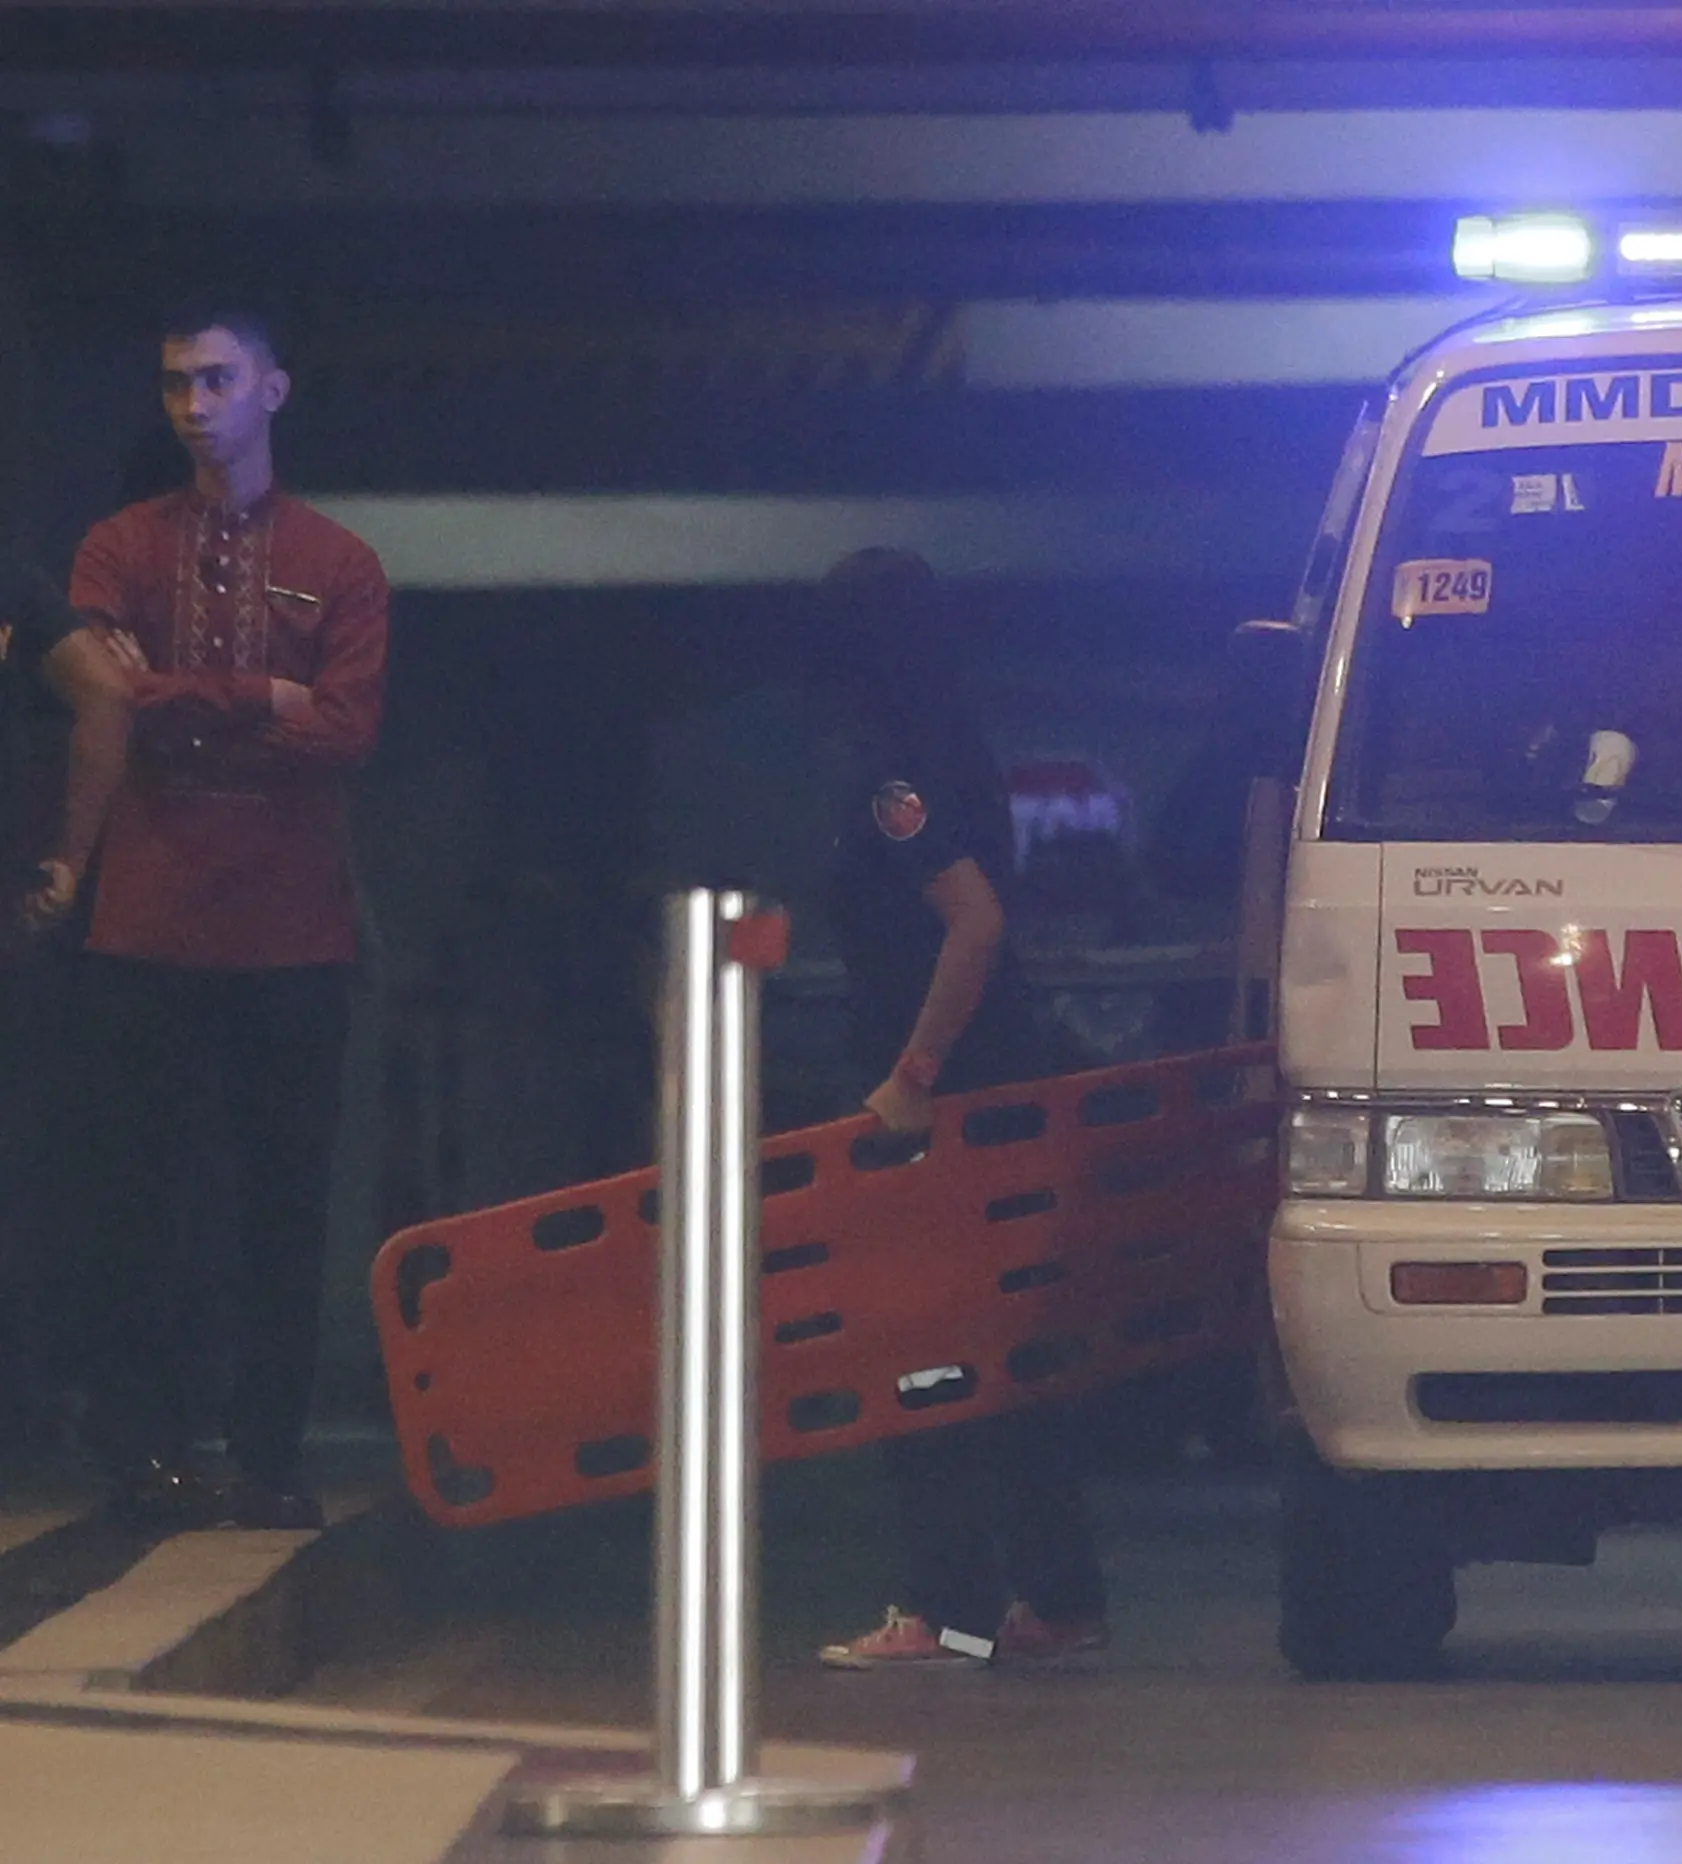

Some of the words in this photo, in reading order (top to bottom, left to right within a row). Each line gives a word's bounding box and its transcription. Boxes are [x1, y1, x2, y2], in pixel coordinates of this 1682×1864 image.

[1418, 571, 1488, 603] 1249
[1414, 867, 1479, 879] NISSAN
[1413, 878, 1563, 896] URVAN
